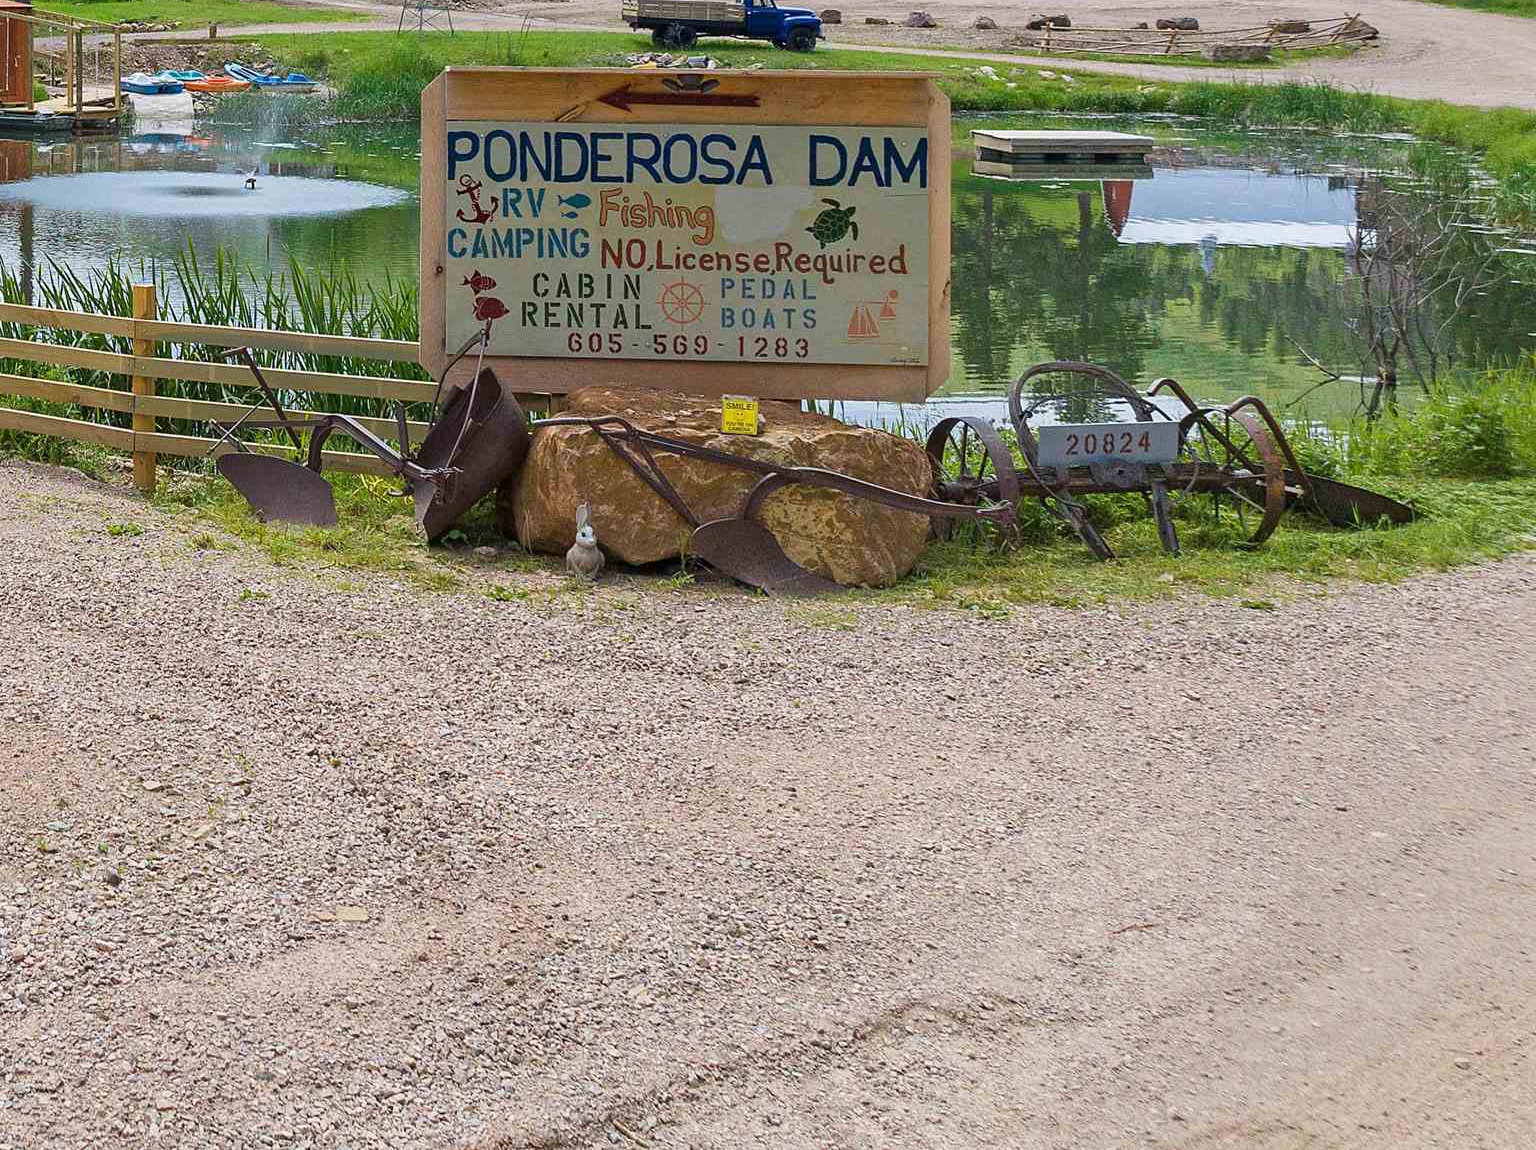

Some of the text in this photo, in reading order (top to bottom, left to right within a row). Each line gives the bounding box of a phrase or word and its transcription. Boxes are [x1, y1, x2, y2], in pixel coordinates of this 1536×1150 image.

[447, 129, 929, 189] PONDEROSA DAM
[501, 187, 546, 219] RV
[599, 187, 715, 246] Fishing
[447, 227, 590, 260] CAMPING
[532, 272, 641, 300] CABIN
[721, 277, 817, 300] PEDAL
[521, 301, 652, 330] RENTAL
[721, 307, 817, 329] BOATS
[1065, 431, 1151, 456] 20824
